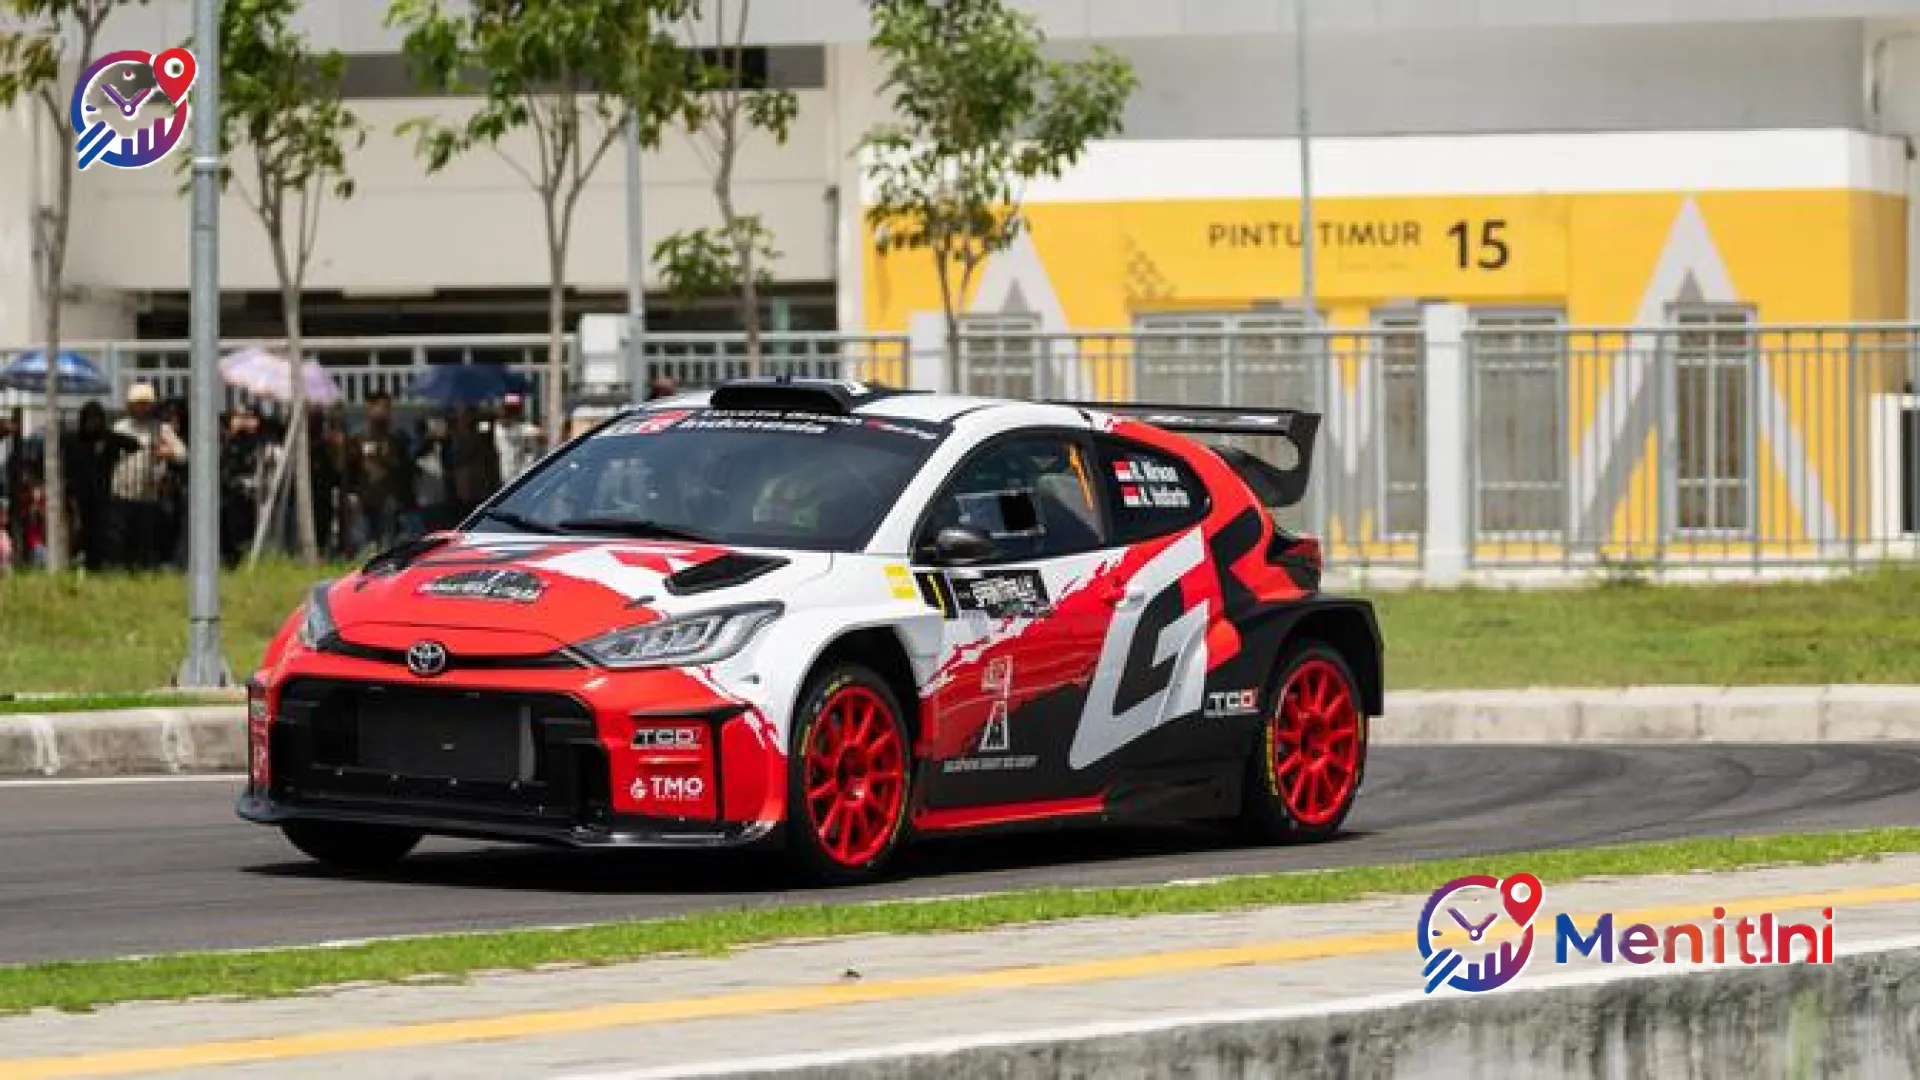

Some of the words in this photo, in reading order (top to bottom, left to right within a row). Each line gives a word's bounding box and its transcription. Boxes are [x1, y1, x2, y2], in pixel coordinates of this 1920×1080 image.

[1208, 222, 1304, 247] PINTU
[1318, 220, 1421, 246] TIMUR
[1446, 219, 1510, 270] 15
[650, 777, 703, 795] TMO
